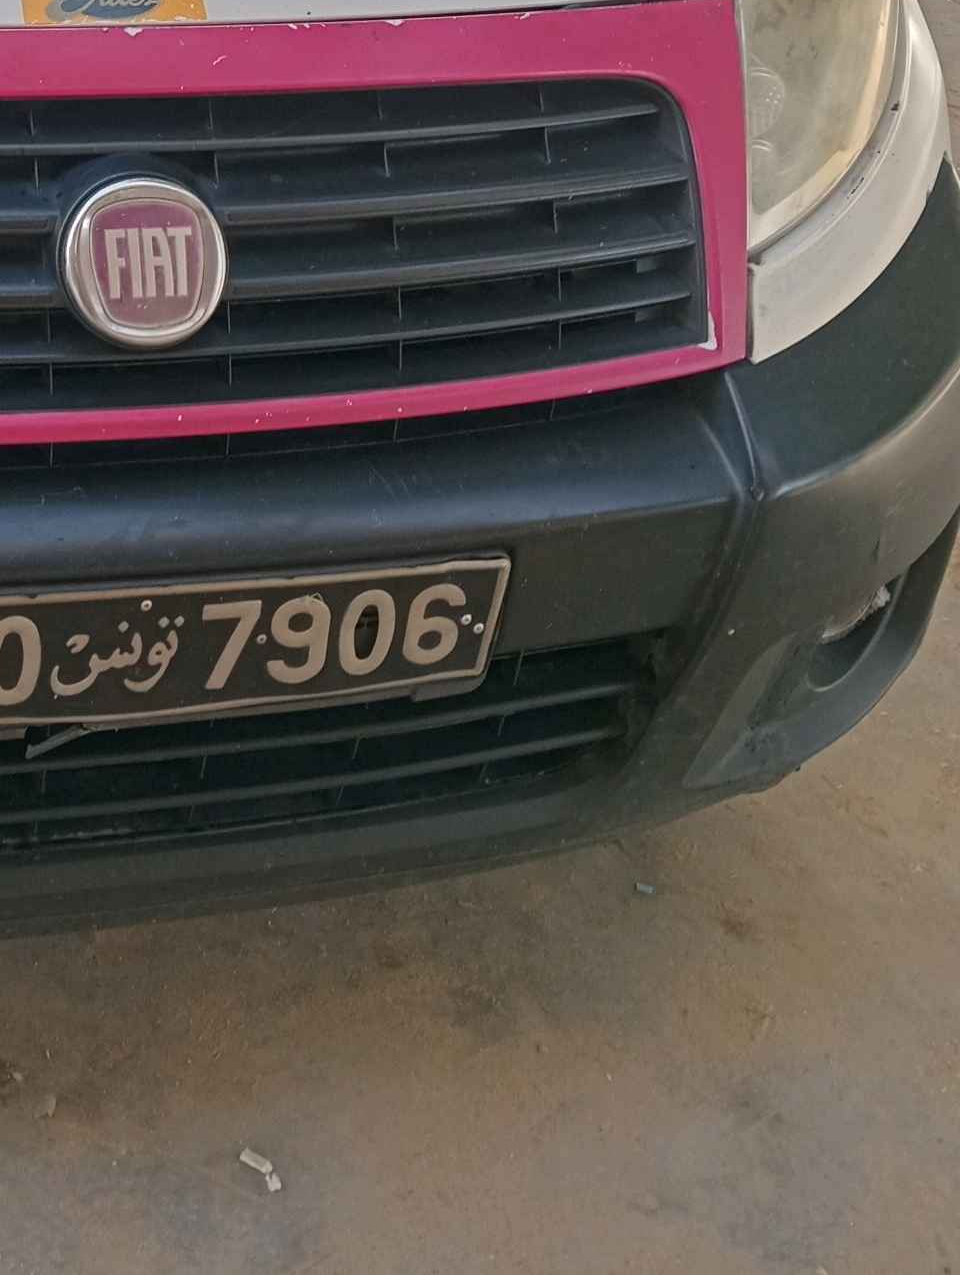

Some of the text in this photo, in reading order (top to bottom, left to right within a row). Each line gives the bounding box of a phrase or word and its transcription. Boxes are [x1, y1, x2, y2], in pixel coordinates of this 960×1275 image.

[104, 227, 192, 299] FIAT
[50, 616, 184, 693] تونس
[201, 583, 467, 691] 7906
